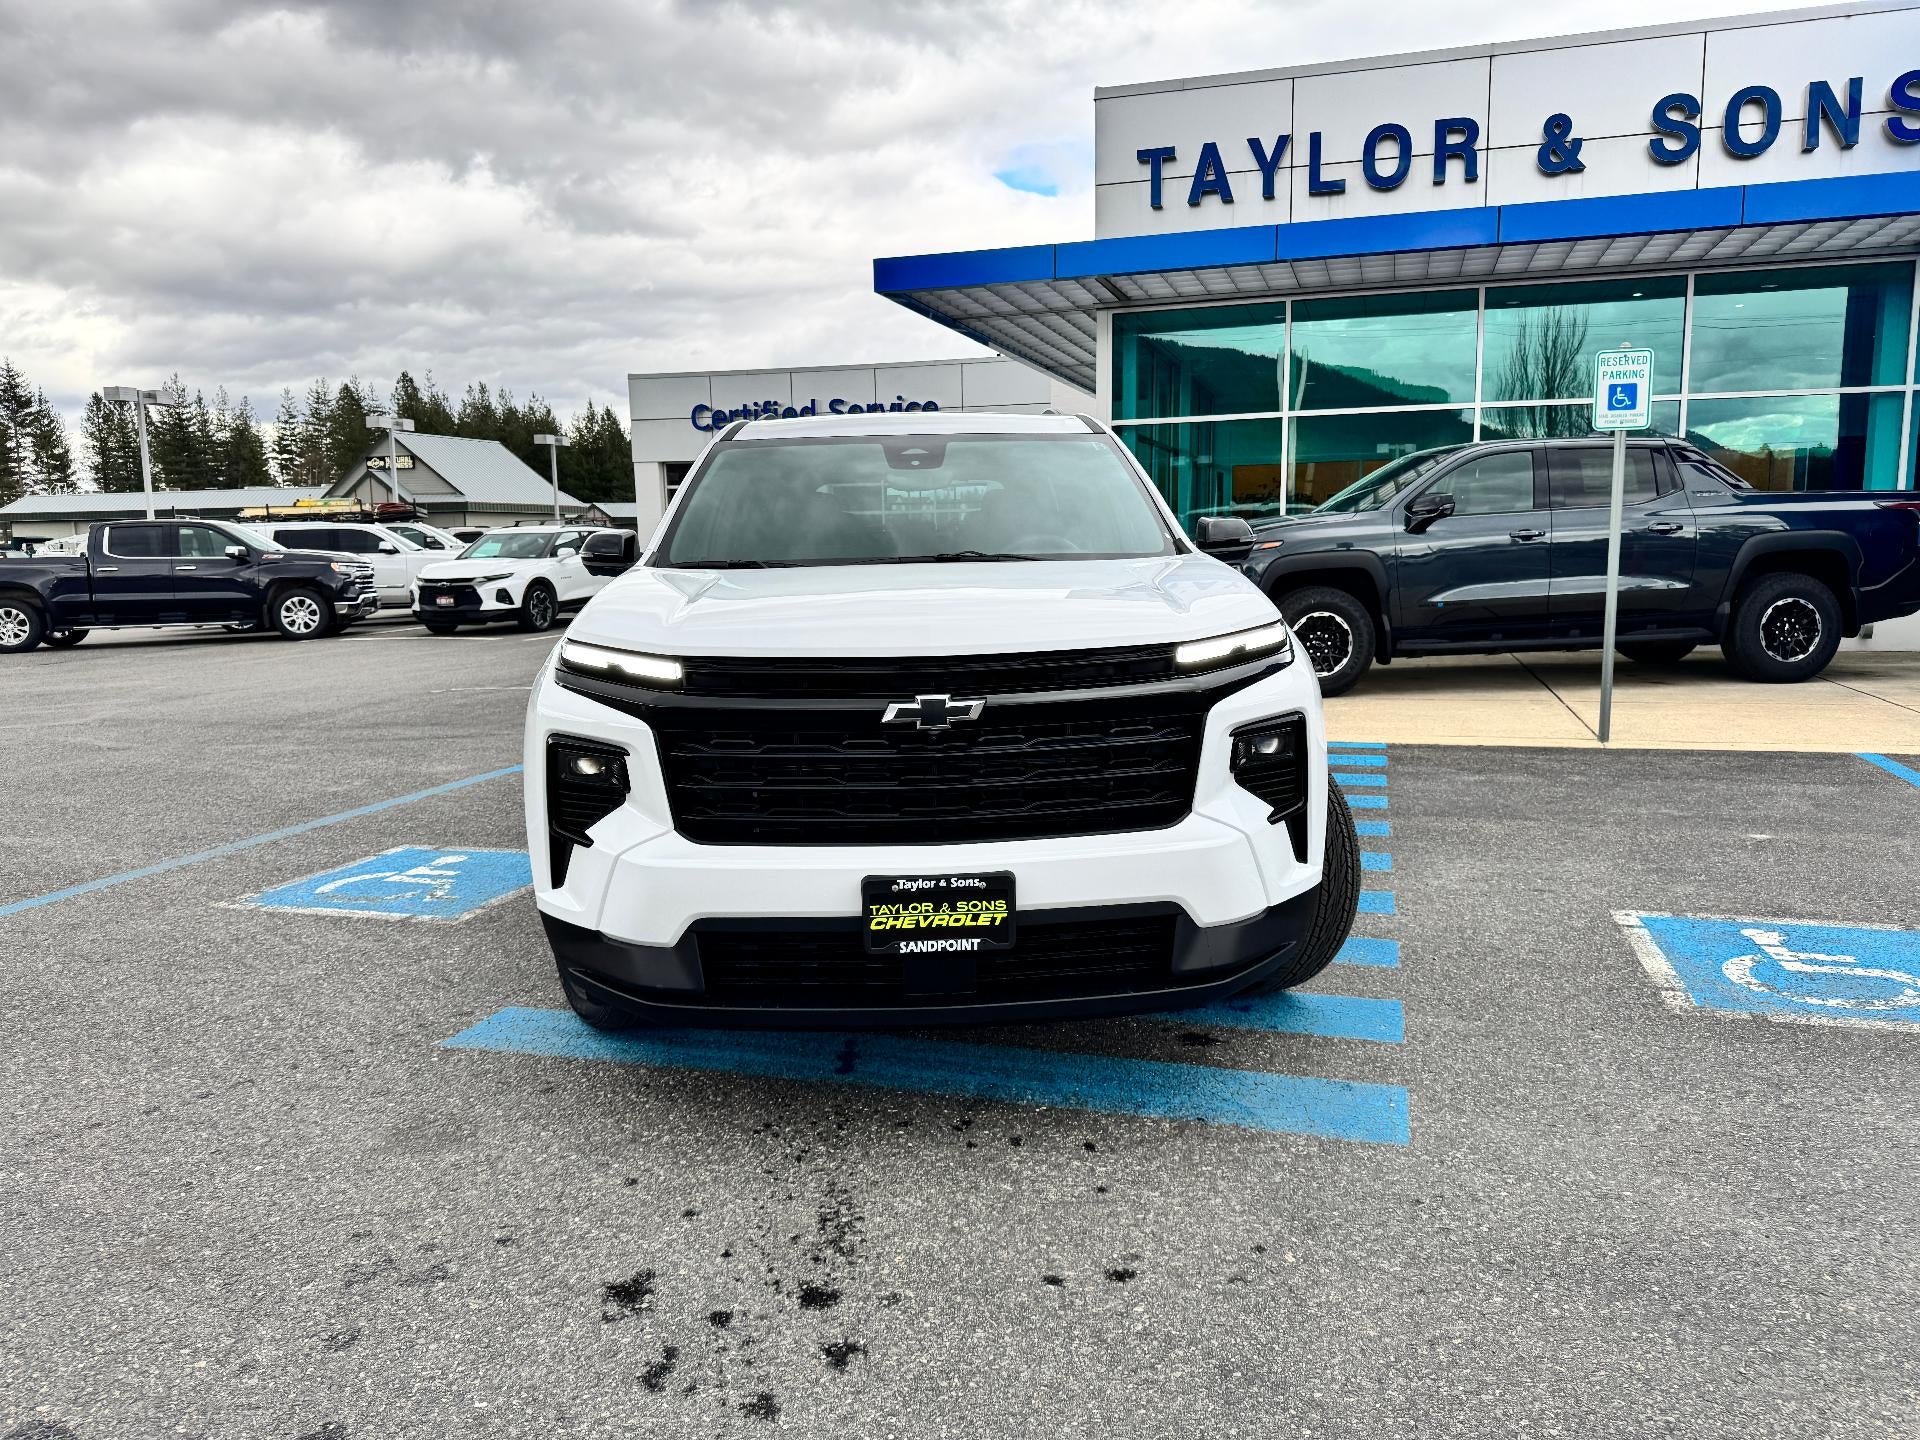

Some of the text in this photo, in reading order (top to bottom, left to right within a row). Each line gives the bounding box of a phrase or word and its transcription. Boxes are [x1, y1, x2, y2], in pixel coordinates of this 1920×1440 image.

[1136, 69, 1920, 211] TAYLOR & SONS
[1600, 355, 1648, 367] RESERVED
[1602, 369, 1645, 380] PARKING
[691, 398, 816, 432] Certified
[897, 878, 980, 892] Taylor & Sons
[870, 899, 1007, 916] TAYLOR & SONS
[869, 913, 1008, 931] CHEVROLET
[899, 938, 981, 954] SANDPOINT
